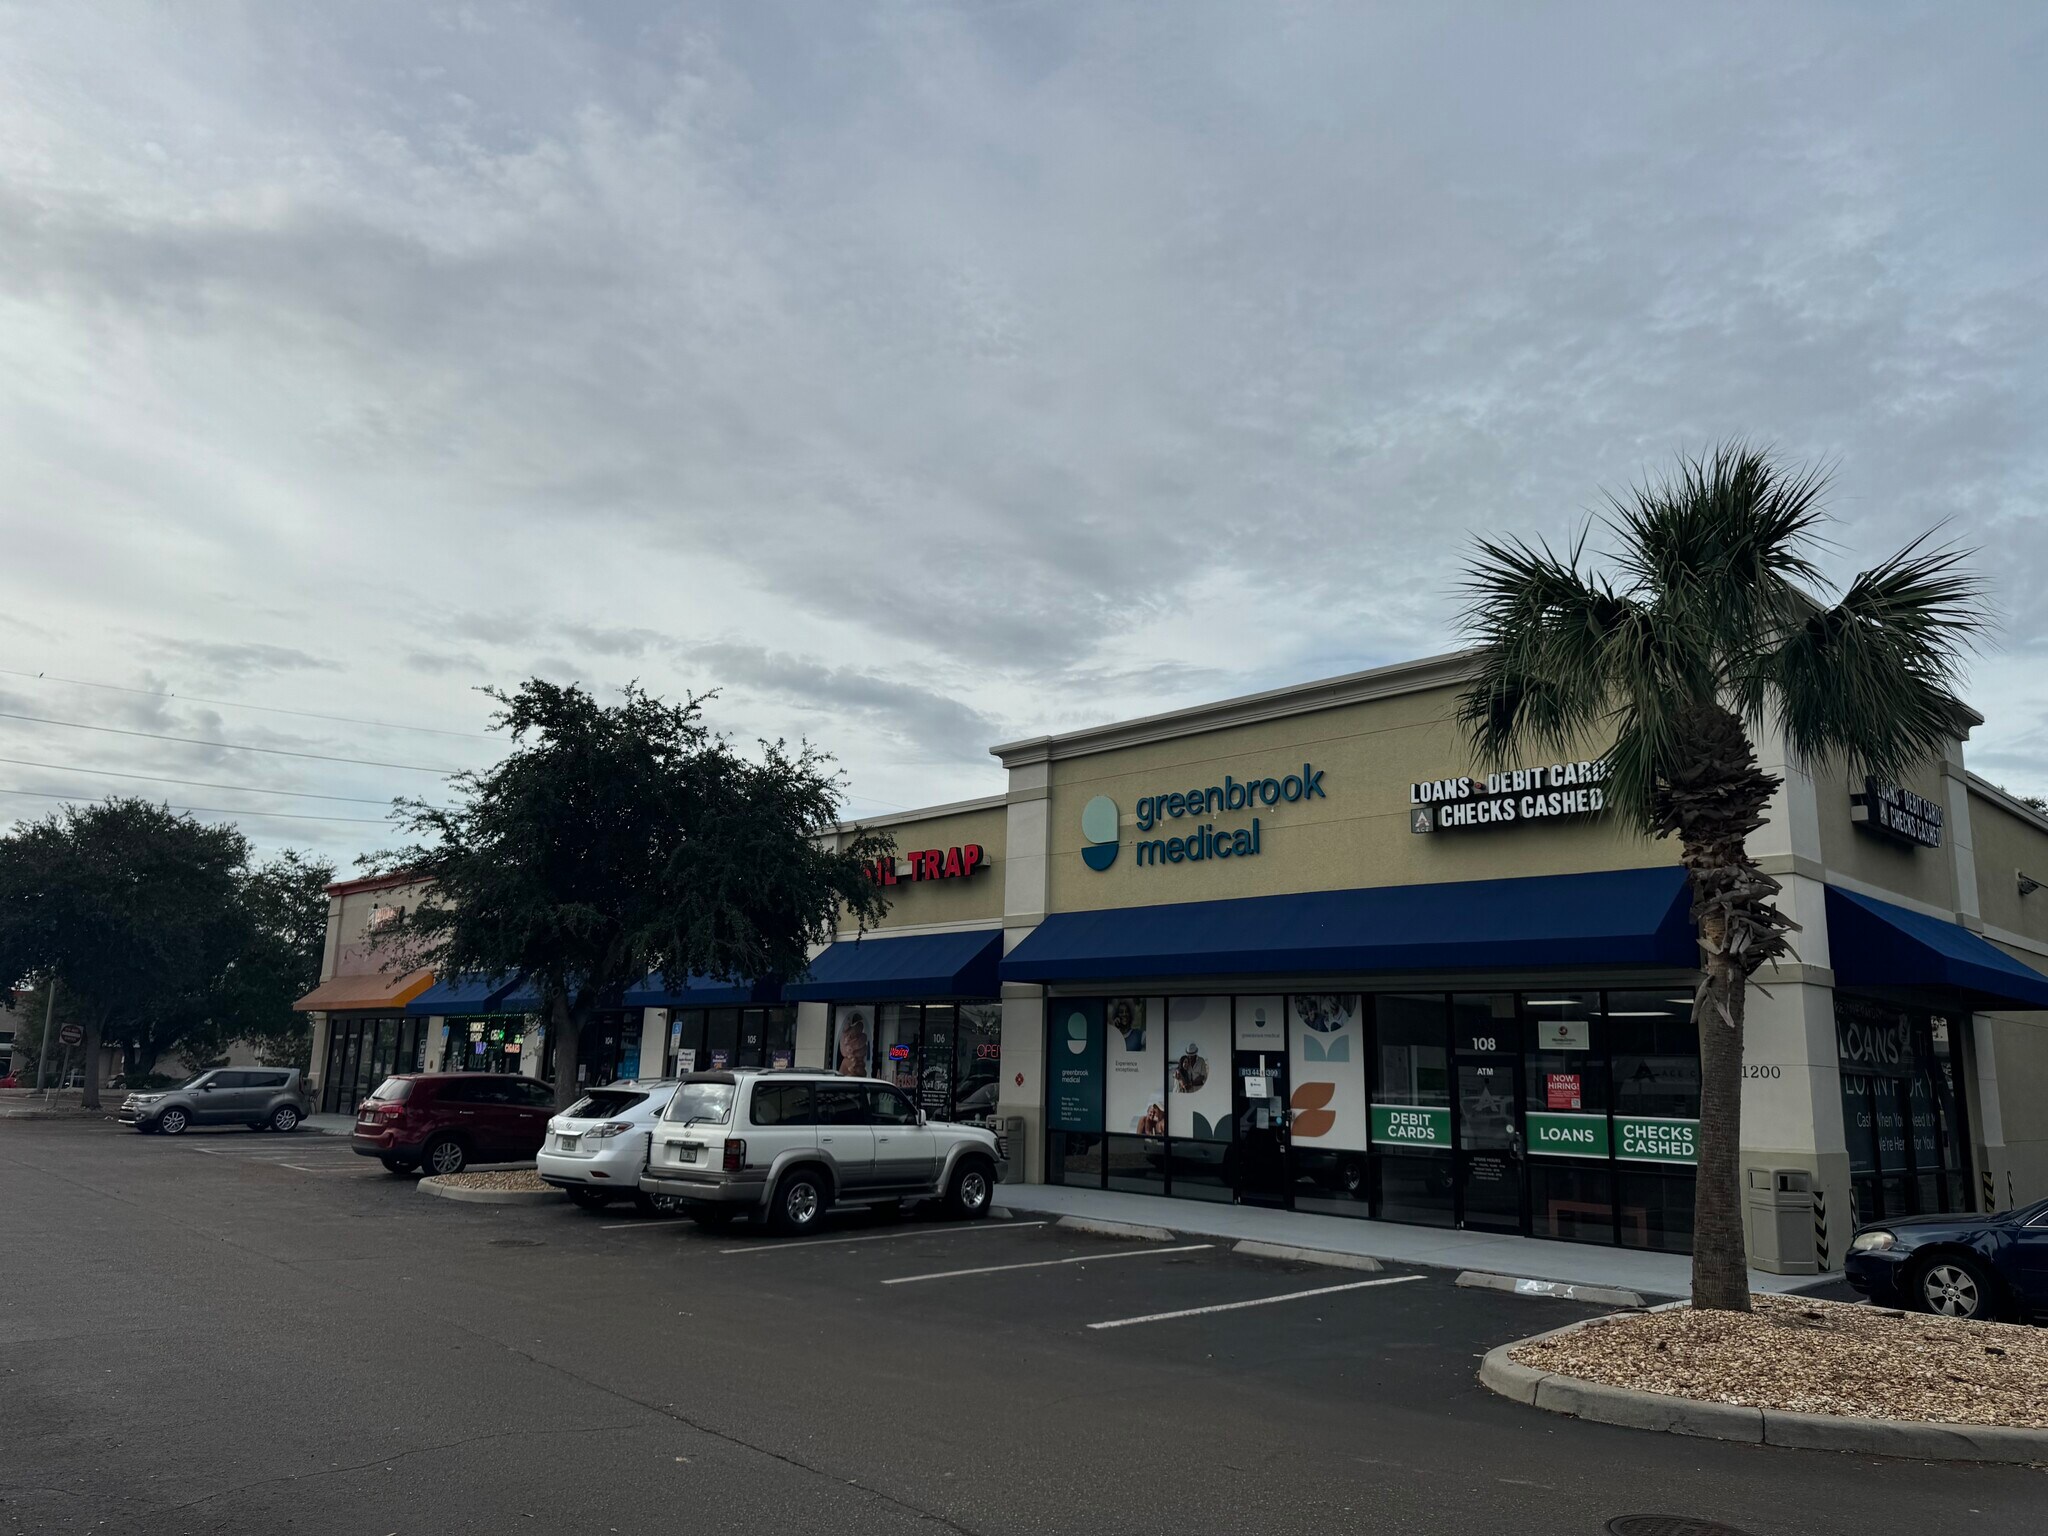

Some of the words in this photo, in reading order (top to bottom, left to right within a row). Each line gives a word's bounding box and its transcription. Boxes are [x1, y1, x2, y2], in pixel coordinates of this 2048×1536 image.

[1410, 776, 1473, 804] LOANS
[1488, 765, 1548, 795] DEBIT
[1550, 760, 1616, 787] CARD
[1136, 763, 1327, 831] greenbrook
[1877, 776, 1900, 807] LOANS
[1441, 798, 1516, 828] CHECKS
[1520, 787, 1604, 819] CASHED
[1890, 805, 1917, 838] CHECKS
[1917, 817, 1941, 848] CASHED
[1136, 818, 1262, 867] medical
[907, 843, 984, 882] TRAP
[933, 1033, 946, 1043] 106
[1472, 1037, 1497, 1051] 108
[1836, 1020, 1899, 1065] LOANS
[1476, 1067, 1494, 1076] ATM
[1552, 1074, 1574, 1082] NOW
[1742, 1065, 1781, 1079] 1200
[1547, 1082, 1579, 1090] HIRING!
[1390, 1112, 1432, 1126] DEBIT
[1388, 1125, 1436, 1140] CARDS
[1540, 1127, 1594, 1143] LOANS
[1623, 1124, 1693, 1141] CHECKS
[1623, 1139, 1695, 1156] CASHED
